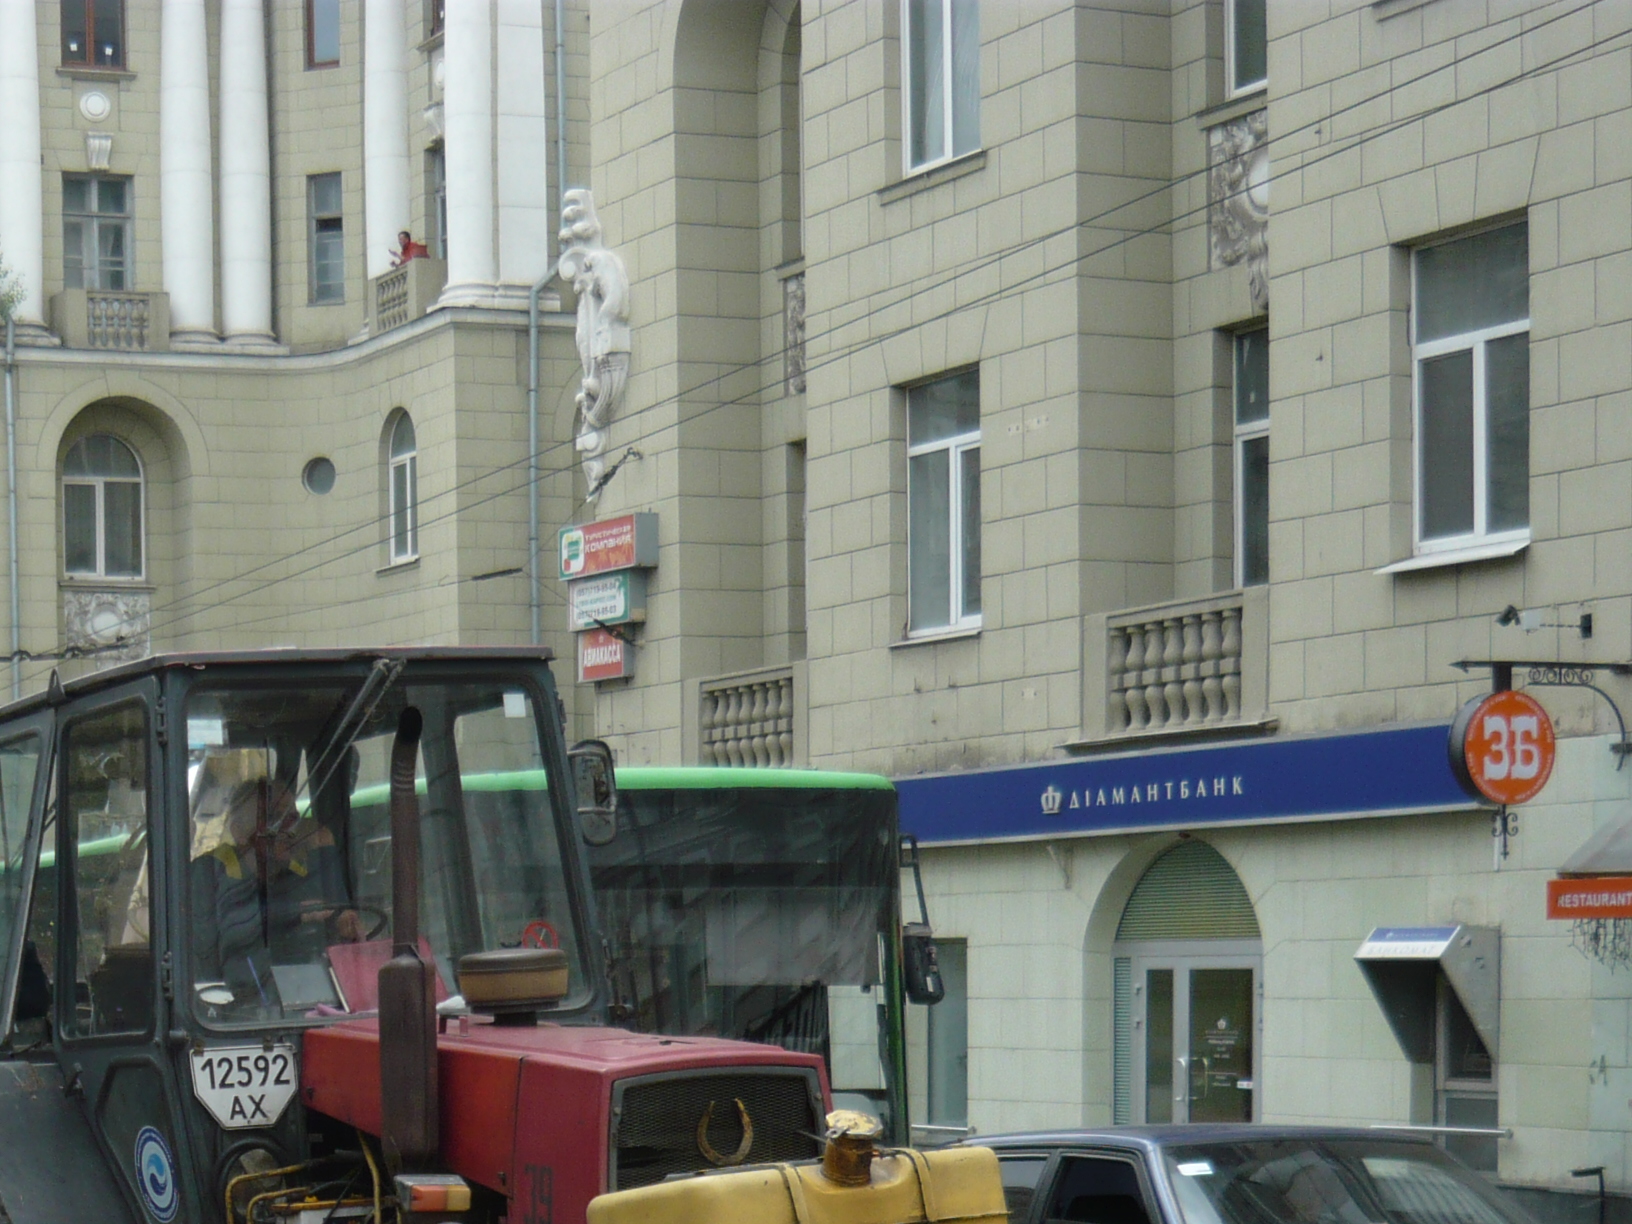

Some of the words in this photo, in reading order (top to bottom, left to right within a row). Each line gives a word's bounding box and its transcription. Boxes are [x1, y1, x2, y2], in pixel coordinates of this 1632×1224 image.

[584, 534, 632, 554] КОМПАНИЯ
[1069, 776, 1243, 809] ДІАМАНТБАНК
[200, 1053, 291, 1090] 12592
